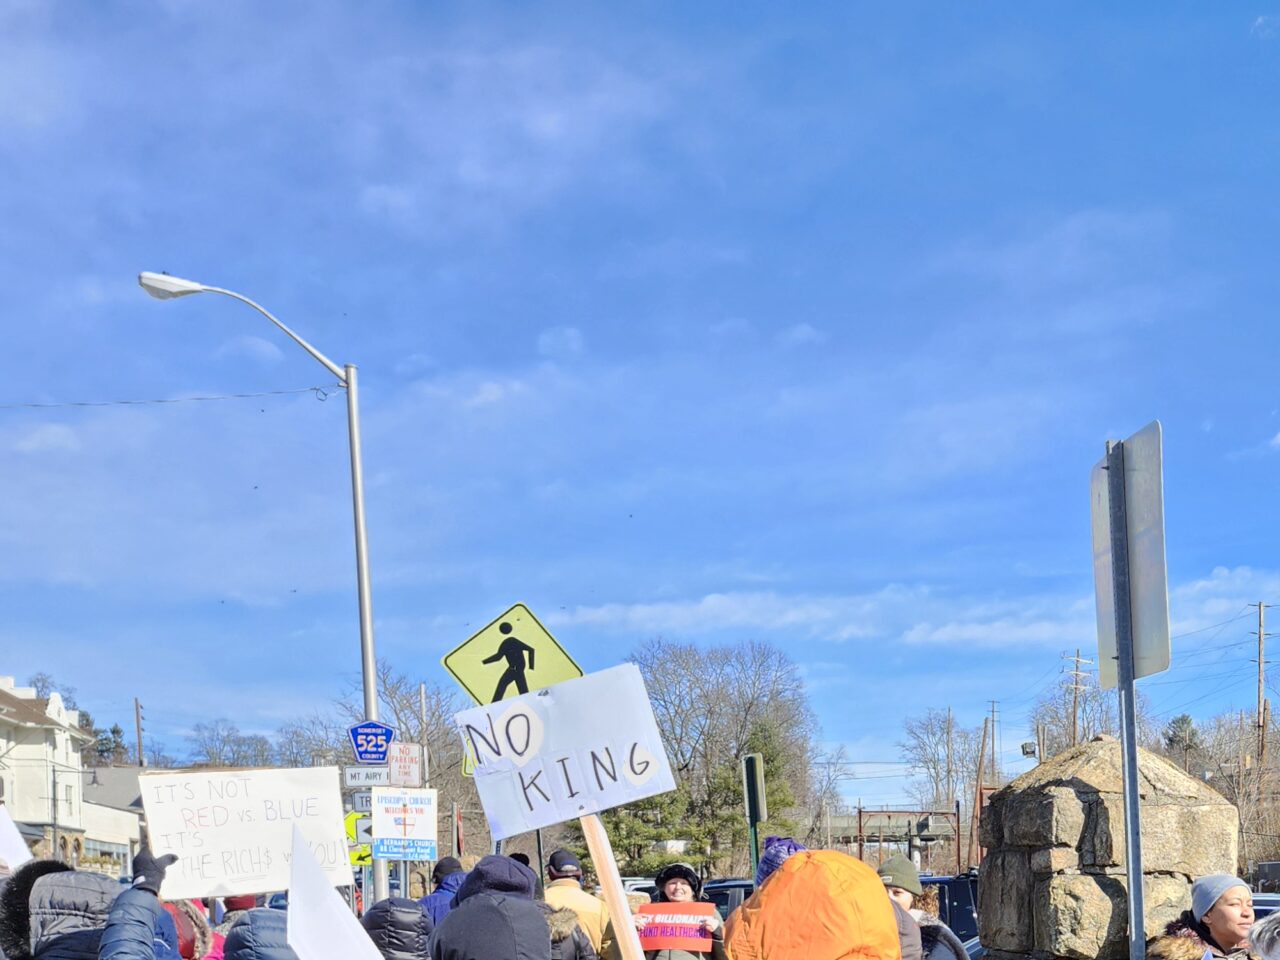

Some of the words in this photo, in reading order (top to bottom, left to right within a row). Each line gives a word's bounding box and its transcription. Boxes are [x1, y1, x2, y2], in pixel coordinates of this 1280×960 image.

[357, 735, 387, 752] 525
[466, 713, 531, 764] NO
[391, 756, 418, 764] PARKING
[399, 747, 410, 755] NO
[350, 772, 361, 781] MT
[364, 771, 382, 780] AIRY
[518, 742, 650, 811] KING
[153, 782, 195, 804] IT'S
[208, 778, 252, 800] NOT
[180, 805, 229, 829] RED
[263, 798, 319, 821] BLUE
[160, 831, 204, 849] IT'S
[180, 853, 212, 880] THE
